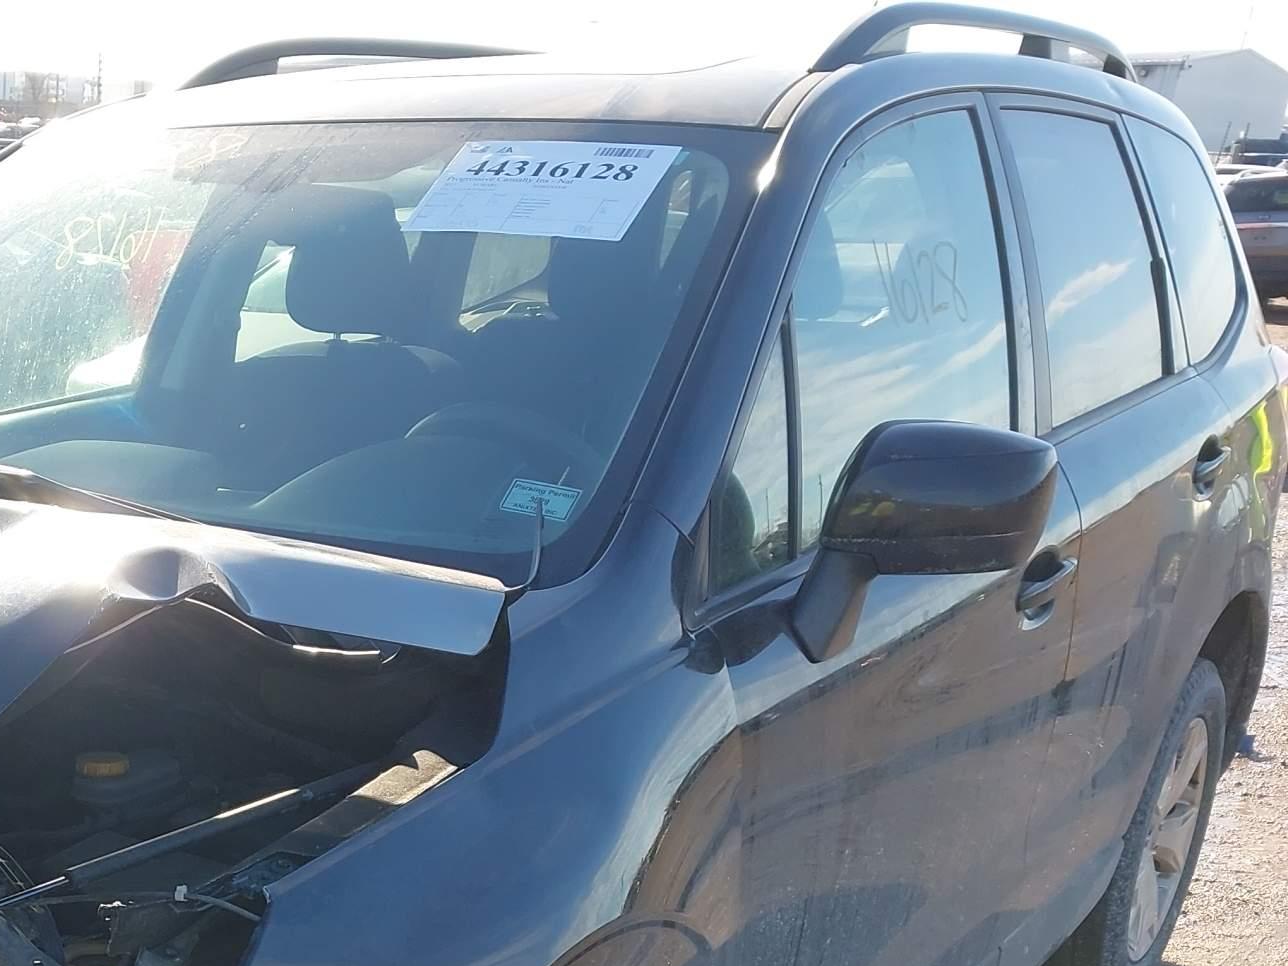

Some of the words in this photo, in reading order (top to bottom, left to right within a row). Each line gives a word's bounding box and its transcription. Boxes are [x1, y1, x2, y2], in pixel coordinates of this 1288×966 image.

[466, 159, 639, 182] 44316128
[515, 484, 546, 495] Parking
[548, 489, 576, 499] Permit
